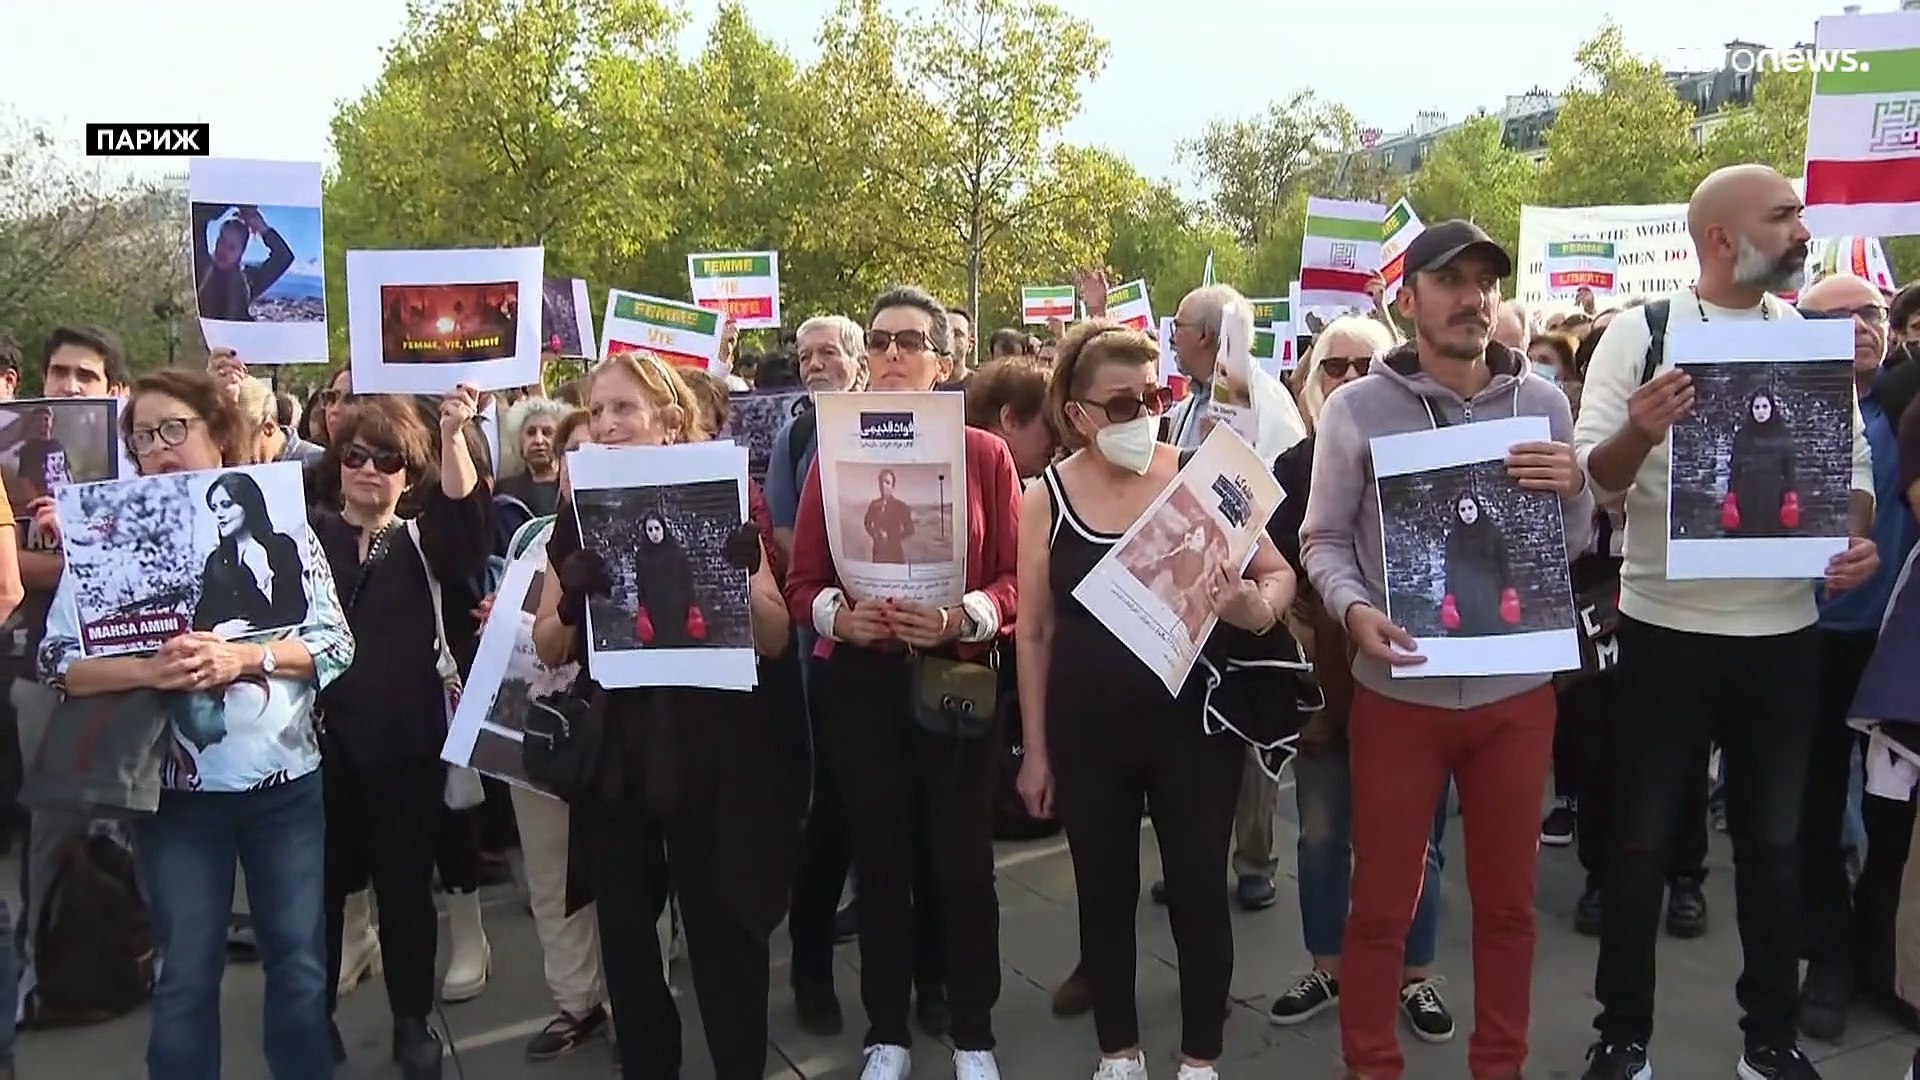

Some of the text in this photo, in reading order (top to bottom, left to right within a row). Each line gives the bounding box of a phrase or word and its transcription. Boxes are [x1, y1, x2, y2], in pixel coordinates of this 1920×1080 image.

[703, 258, 753, 273] FEMME
[1618, 249, 1687, 267] OMEN DO
[633, 301, 698, 326] FEMME
[88, 617, 180, 641] MAHSA AMINI
